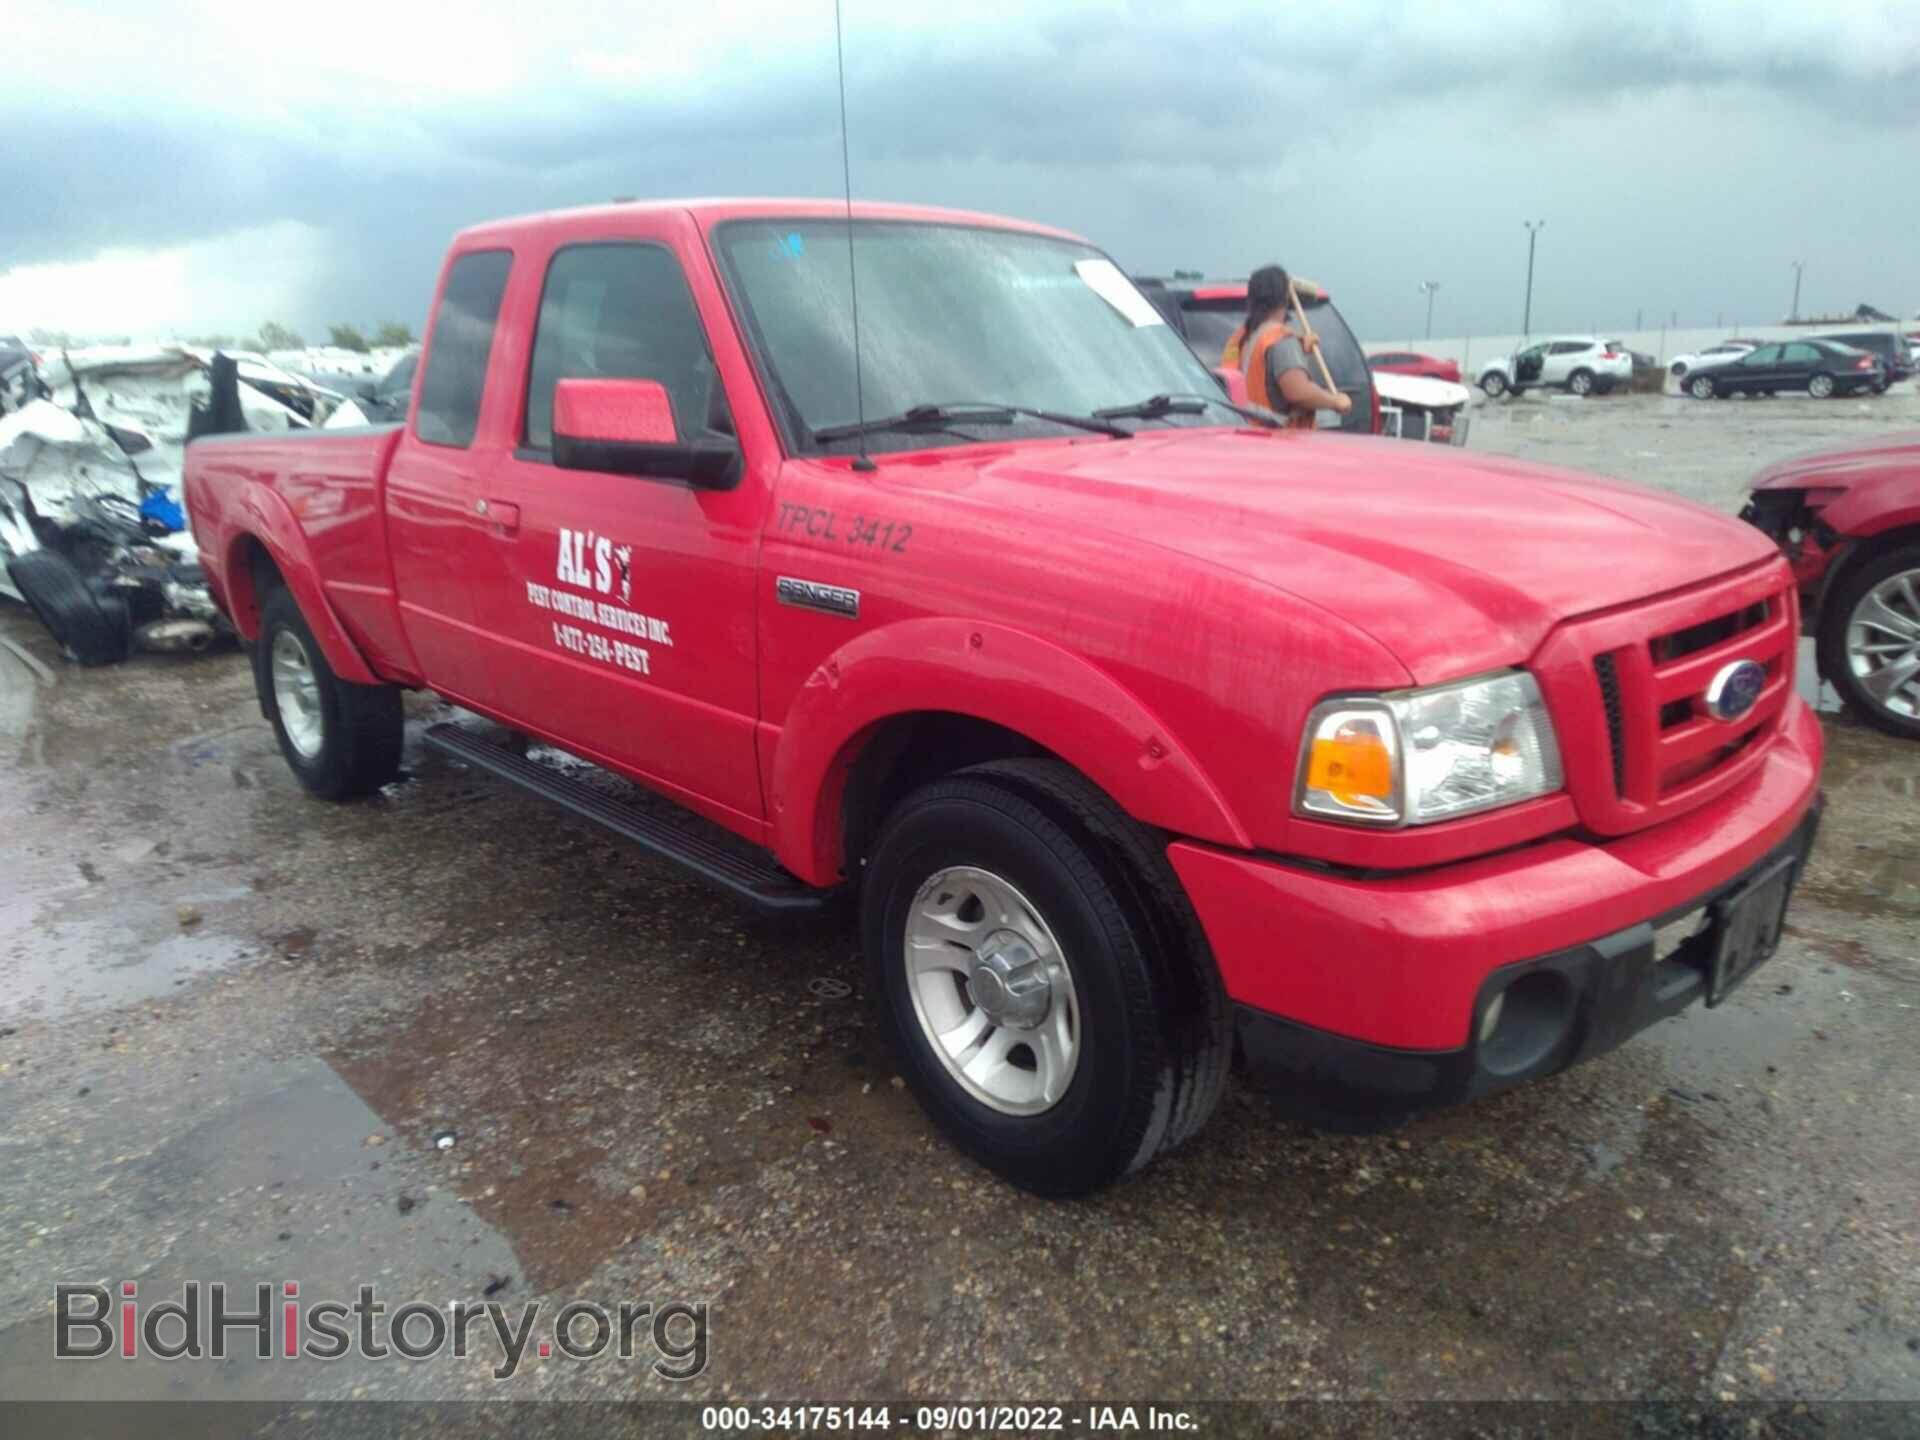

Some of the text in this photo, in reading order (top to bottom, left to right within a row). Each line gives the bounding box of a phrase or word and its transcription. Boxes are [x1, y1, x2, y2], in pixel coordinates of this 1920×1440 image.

[847, 514, 913, 552] 3412
[556, 527, 613, 594] AL'S
[550, 588, 597, 624] CONTROL
[597, 601, 647, 639] SERVICES
